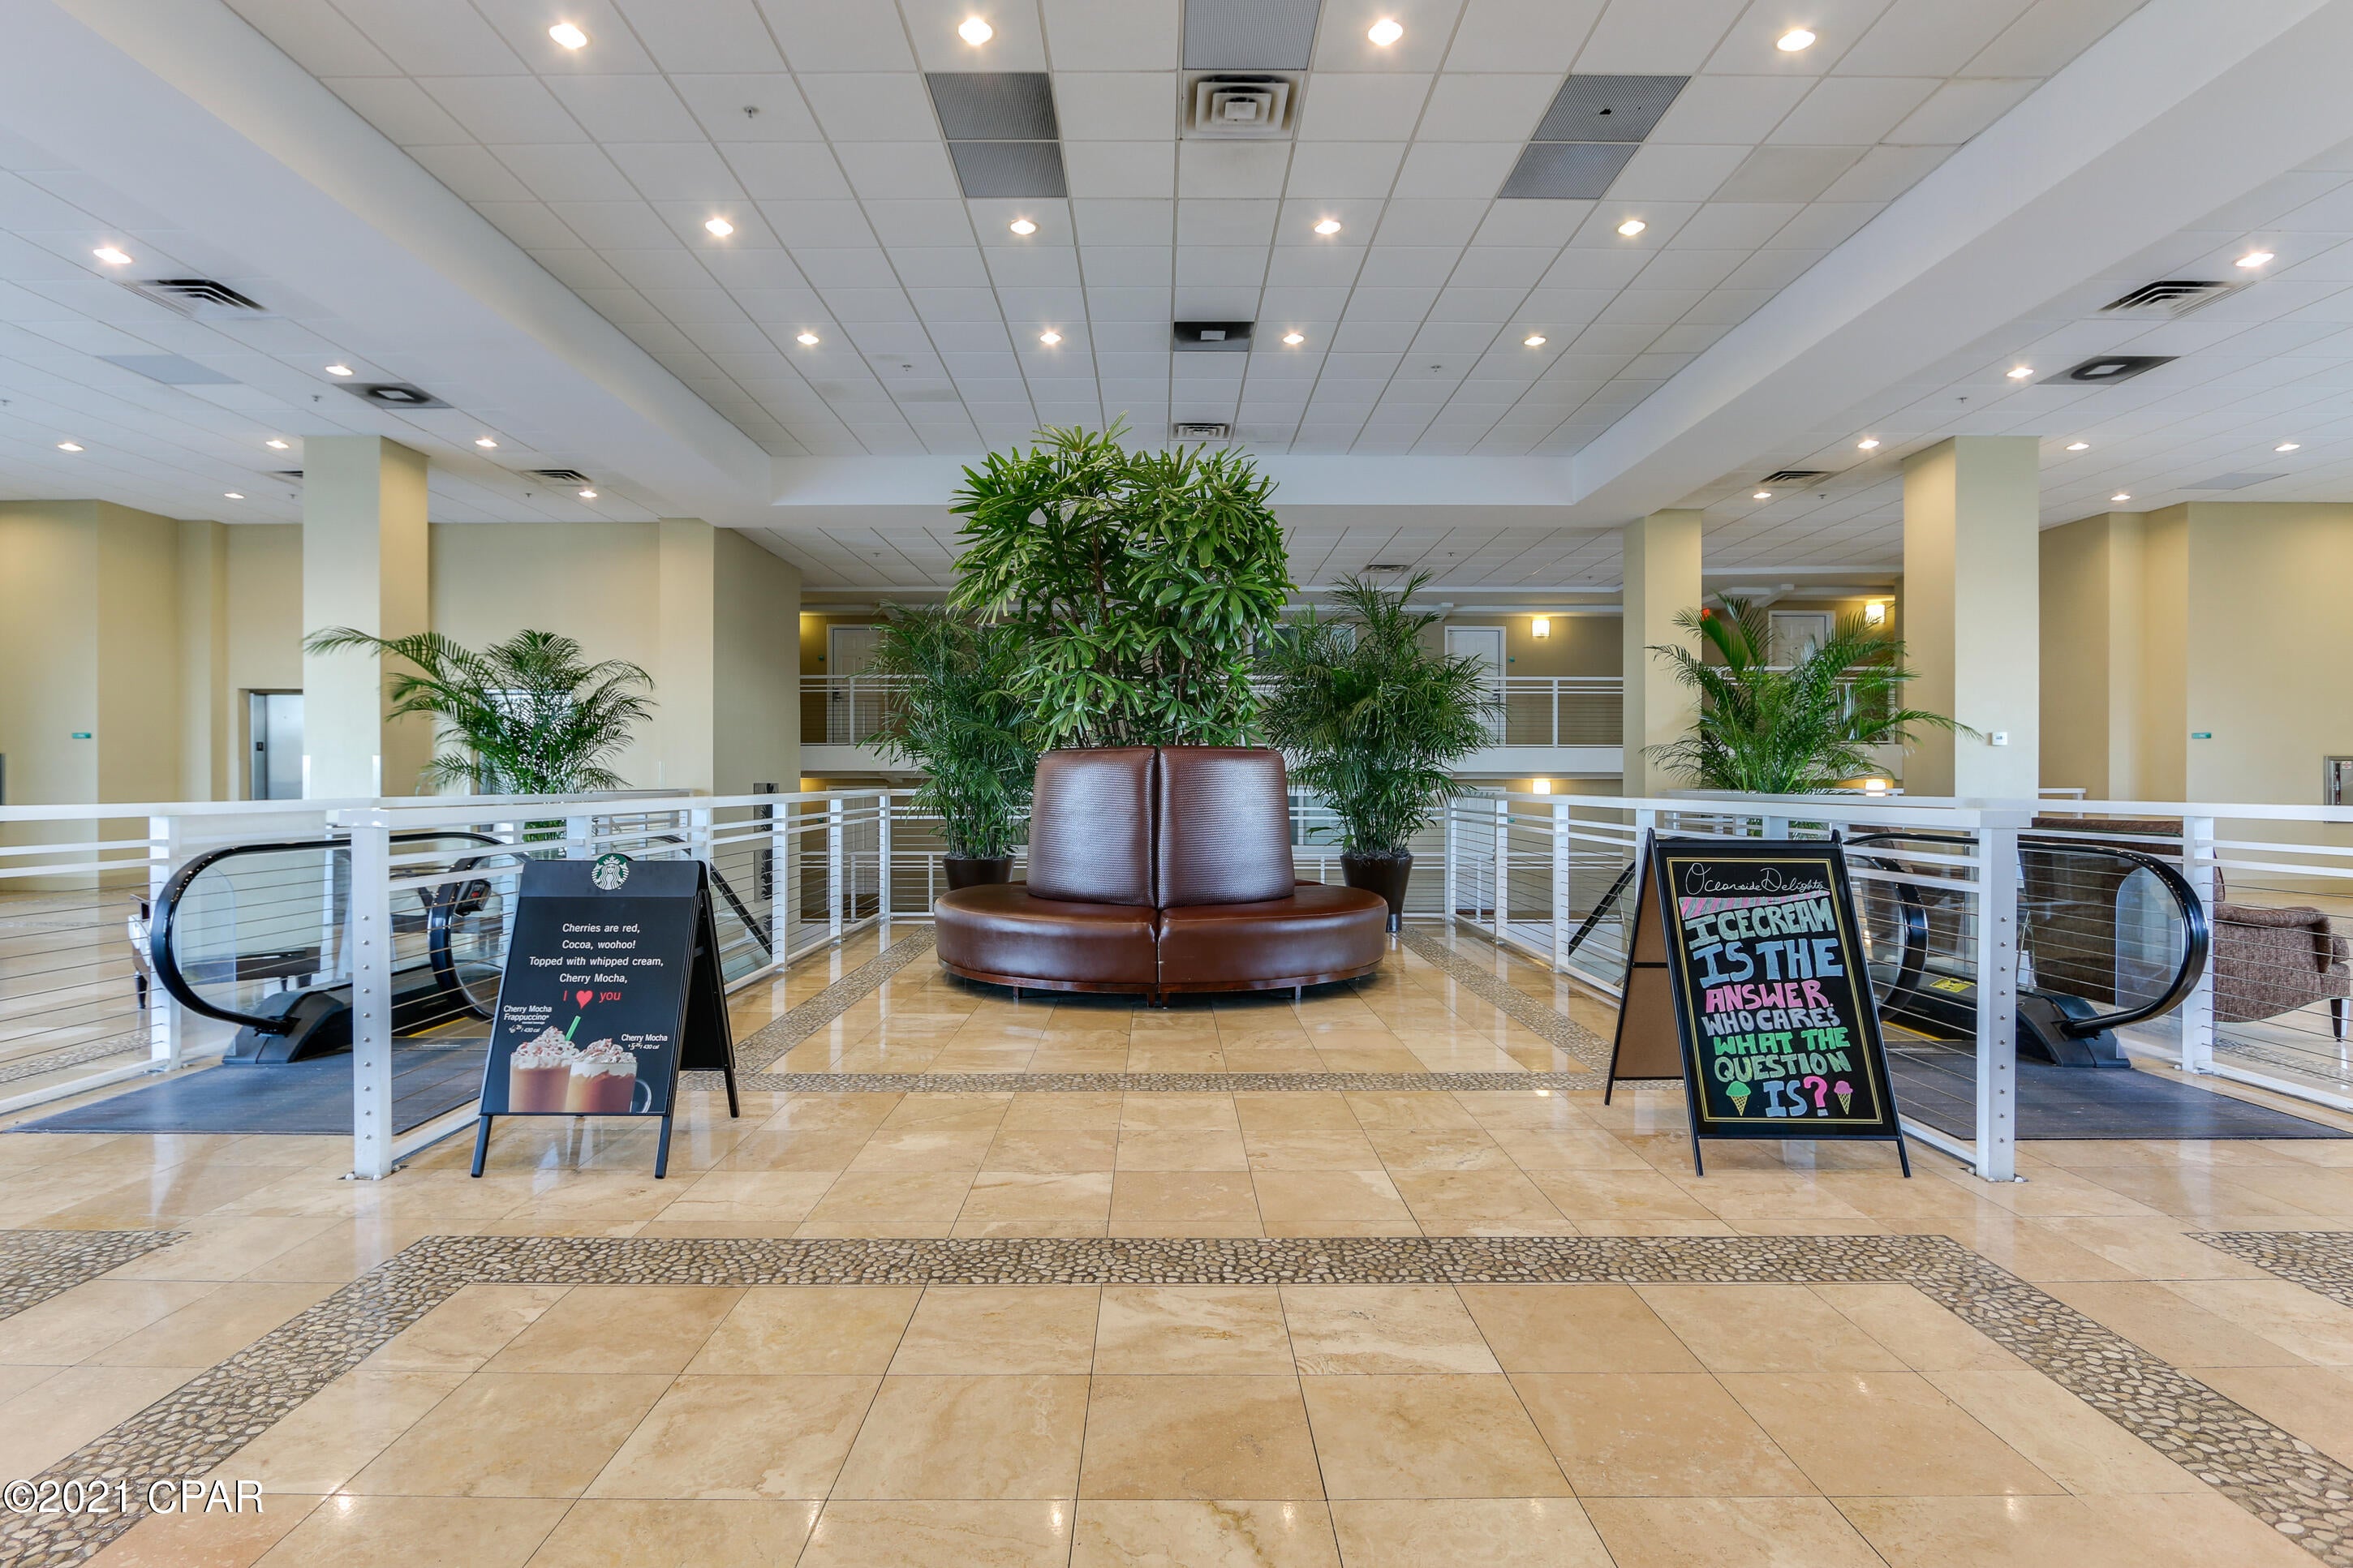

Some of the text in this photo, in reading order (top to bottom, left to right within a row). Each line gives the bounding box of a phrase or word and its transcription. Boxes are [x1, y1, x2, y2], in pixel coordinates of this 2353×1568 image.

[562, 923, 640, 934] Cherries are red,
[561, 939, 636, 950] Cocoa, woohoo!
[529, 956, 664, 968] Topped with whipped cream,
[1693, 938, 1843, 989] IS THE
[559, 973, 628, 985] Cherry Mocha,
[562, 990, 622, 1003] I you
[503, 1005, 527, 1014] Cherry
[621, 1033, 668, 1042] Cherry Mocha
[1713, 1026, 1851, 1055] WHAT THE
[1714, 1050, 1852, 1083] QUESTION
